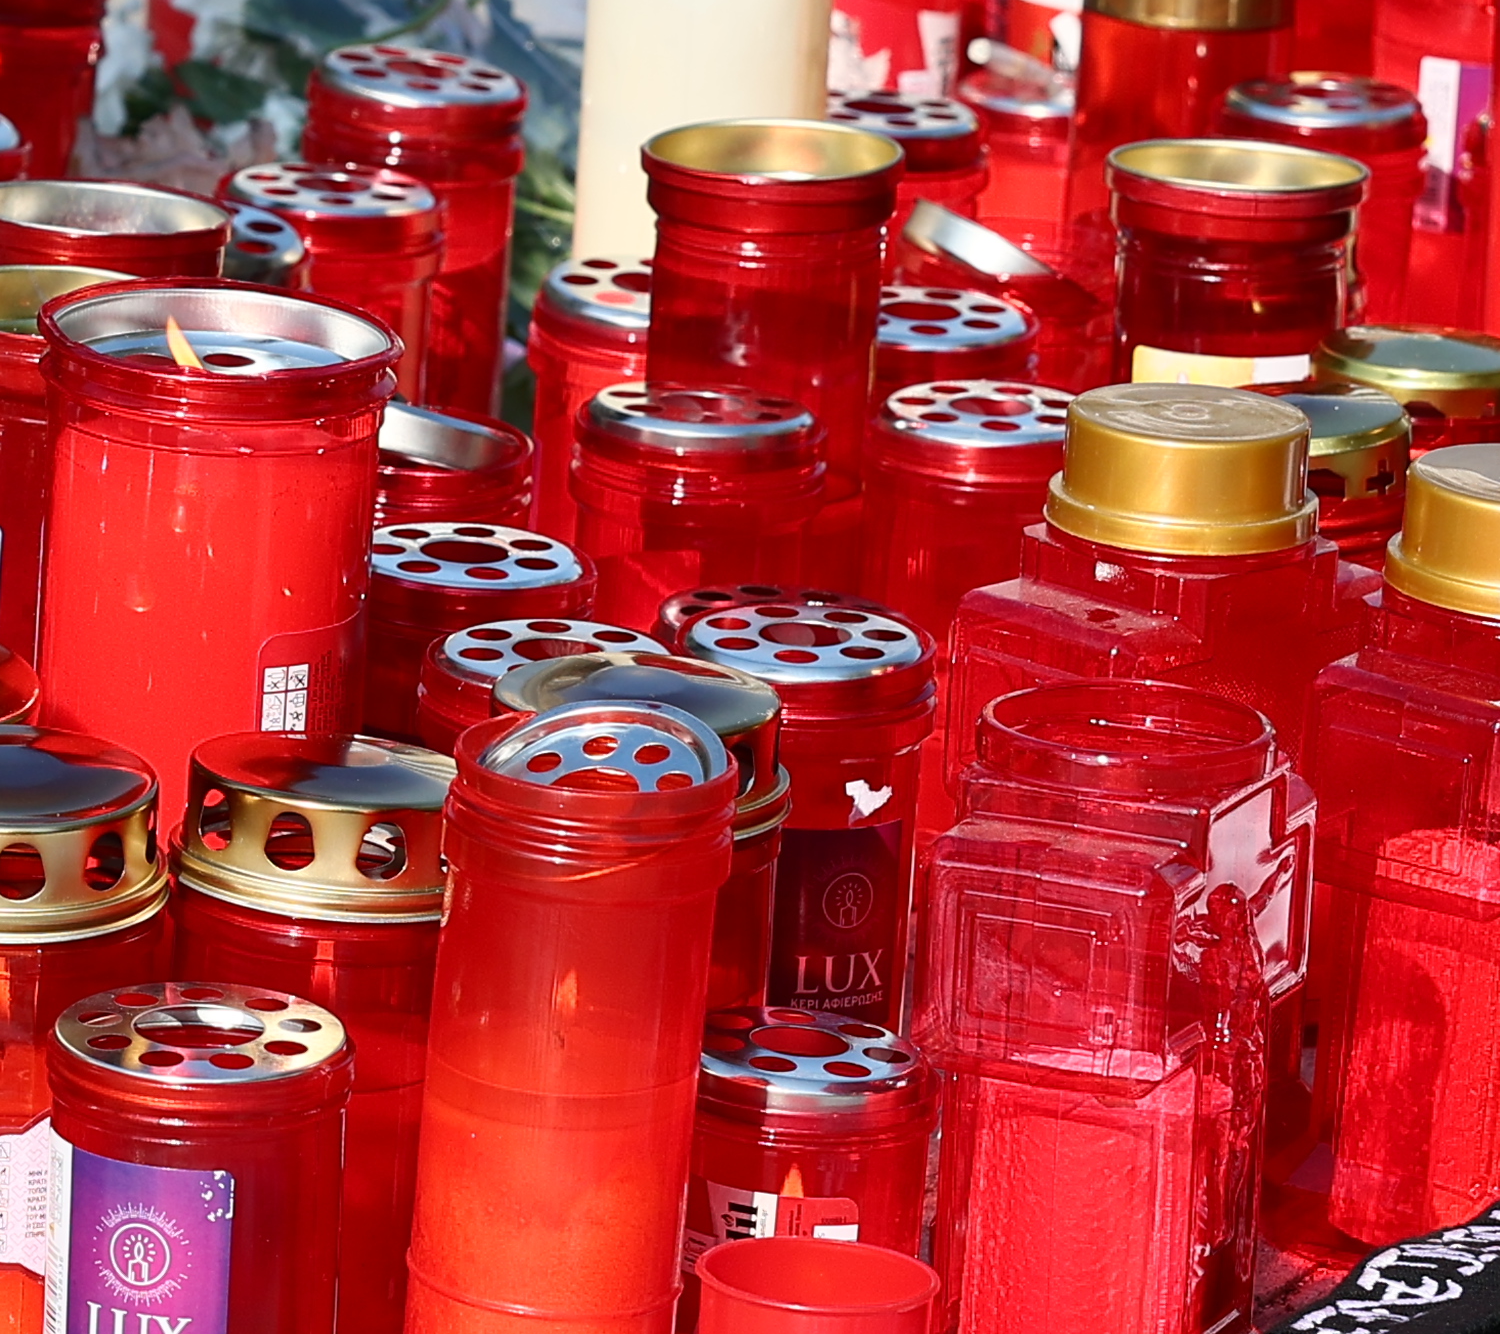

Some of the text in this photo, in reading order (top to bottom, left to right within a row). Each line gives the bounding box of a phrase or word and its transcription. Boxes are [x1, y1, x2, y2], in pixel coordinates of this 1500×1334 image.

[794, 948, 884, 994] LUX
[790, 990, 884, 1010] ΚΕΡΙ ΑΦΙΕΡΩΣΗΣ
